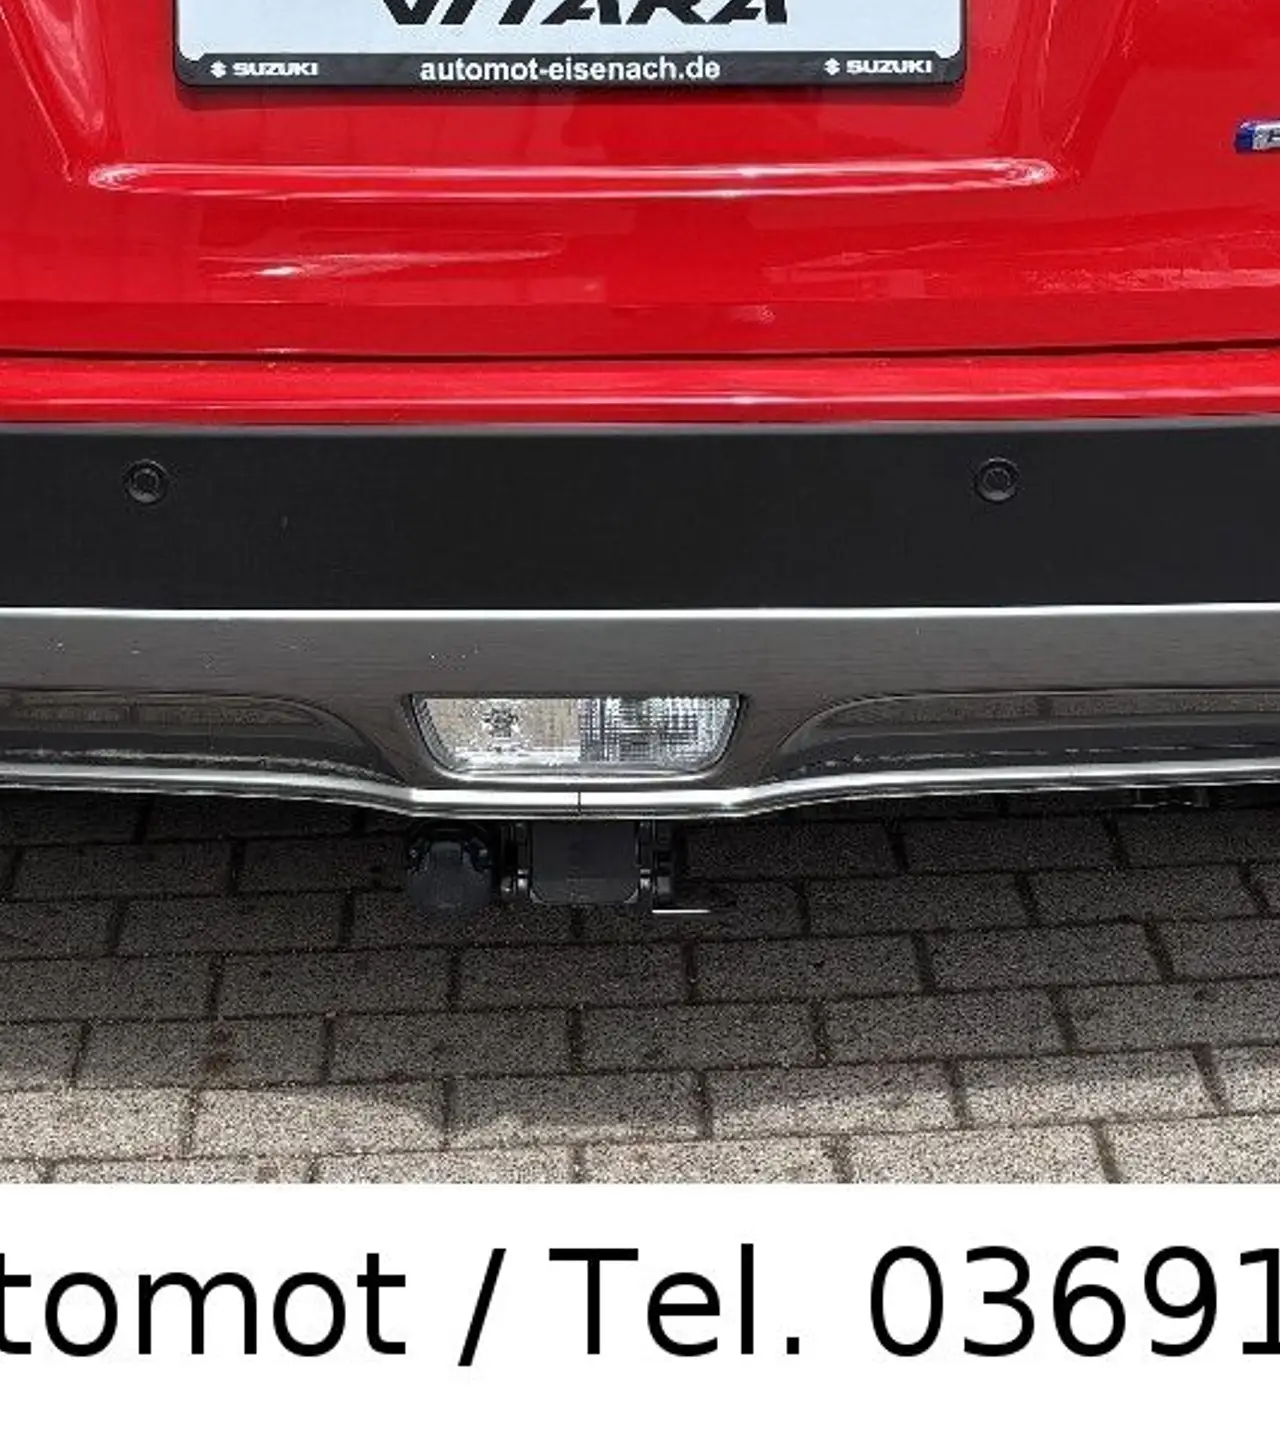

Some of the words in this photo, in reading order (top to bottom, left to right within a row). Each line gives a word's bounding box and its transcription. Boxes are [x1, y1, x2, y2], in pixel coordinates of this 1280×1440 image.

[232, 61, 318, 77] SUZUKI
[419, 57, 721, 82] automot-eisenach.de
[846, 59, 933, 75] SUZUKI
